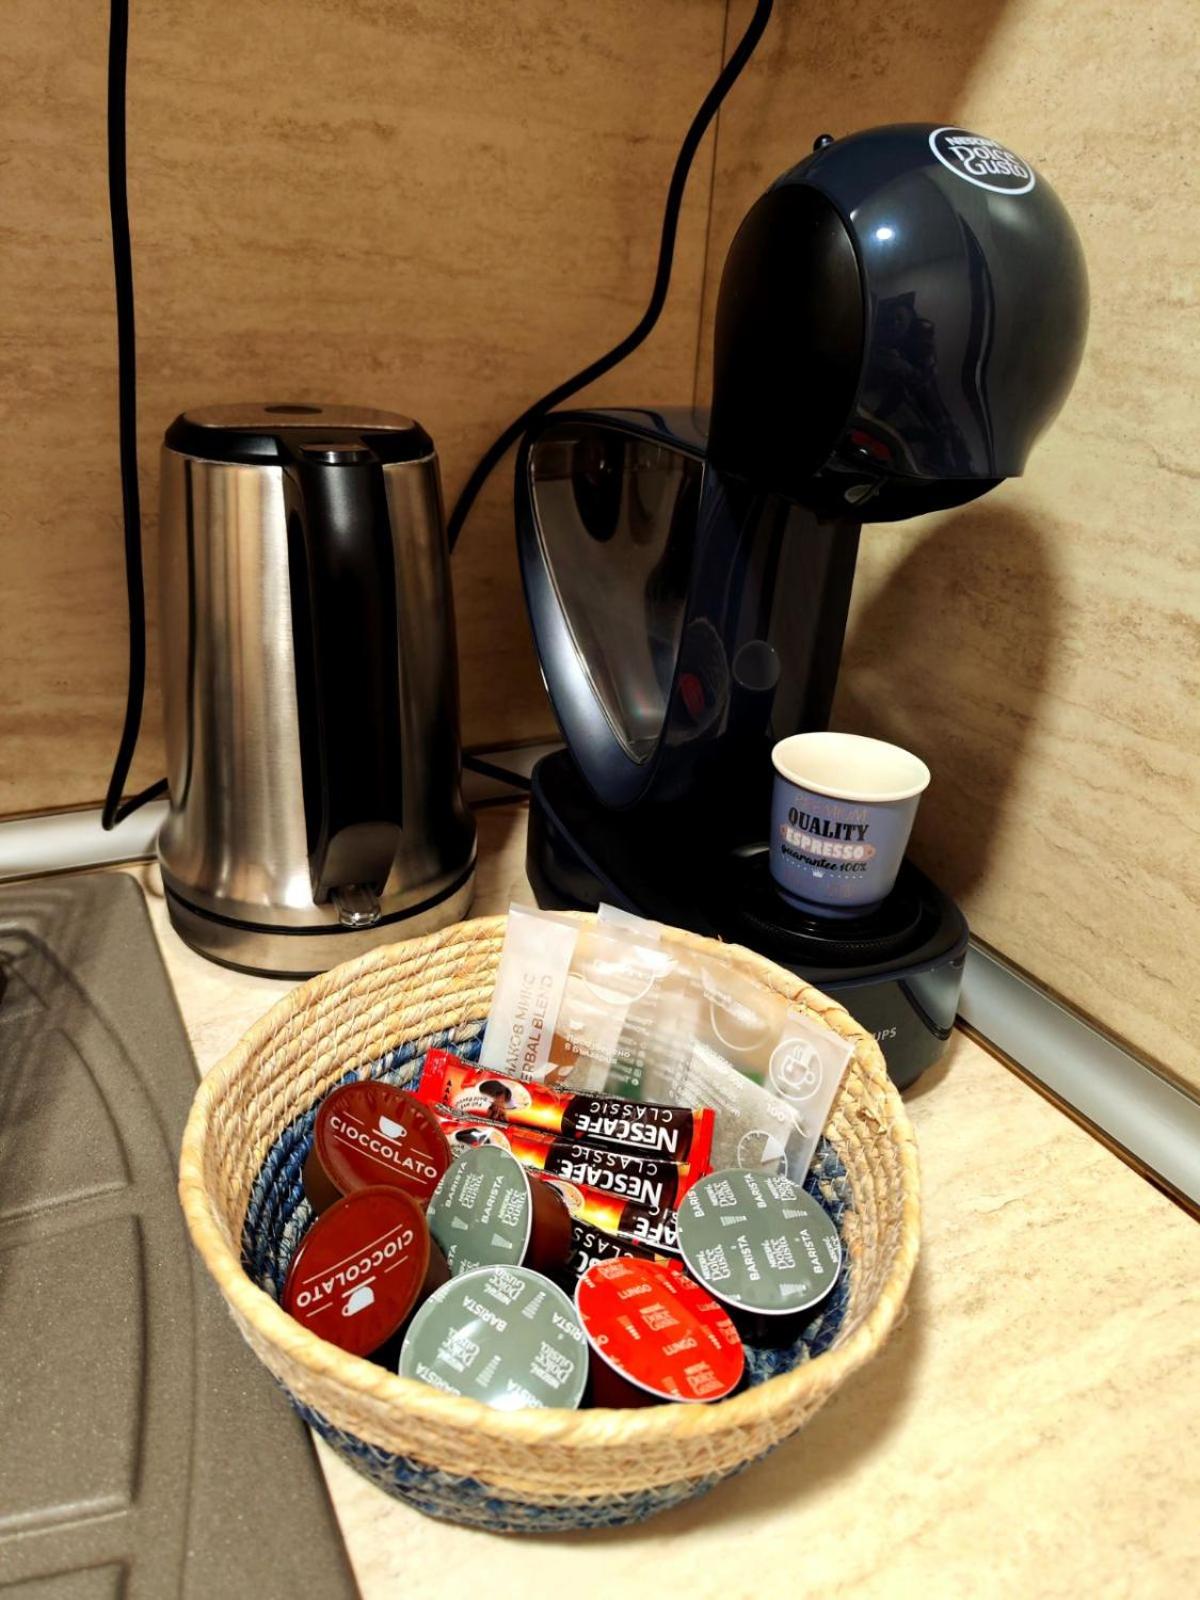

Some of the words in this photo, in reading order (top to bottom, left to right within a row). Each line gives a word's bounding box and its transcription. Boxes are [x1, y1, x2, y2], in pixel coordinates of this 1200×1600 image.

[963, 158, 1029, 179] Gusto
[788, 807, 869, 842] QUALITY
[785, 827, 865, 861] ESPRESSO
[872, 1026, 897, 1041] UPS
[520, 1032, 542, 1082] ERBAL
[589, 1102, 673, 1122] CLASSIC
[330, 1116, 438, 1178] CIOCCOLATO
[571, 1144, 658, 1176] CLASSIC
[445, 1161, 468, 1208] BARISTA
[480, 1175, 505, 1224] BARISTA
[743, 1173, 768, 1208] BARISTA
[687, 1191, 705, 1217] BARIS
[296, 1229, 413, 1308] CIOCCOLATO
[737, 1235, 761, 1281] BARISTA
[800, 1229, 824, 1274] BARISTA
[617, 1283, 653, 1300] LUNGO
[462, 1295, 508, 1332] BARISTA
[551, 1312, 587, 1345] RISTA
[661, 1336, 698, 1356] LUNGO
